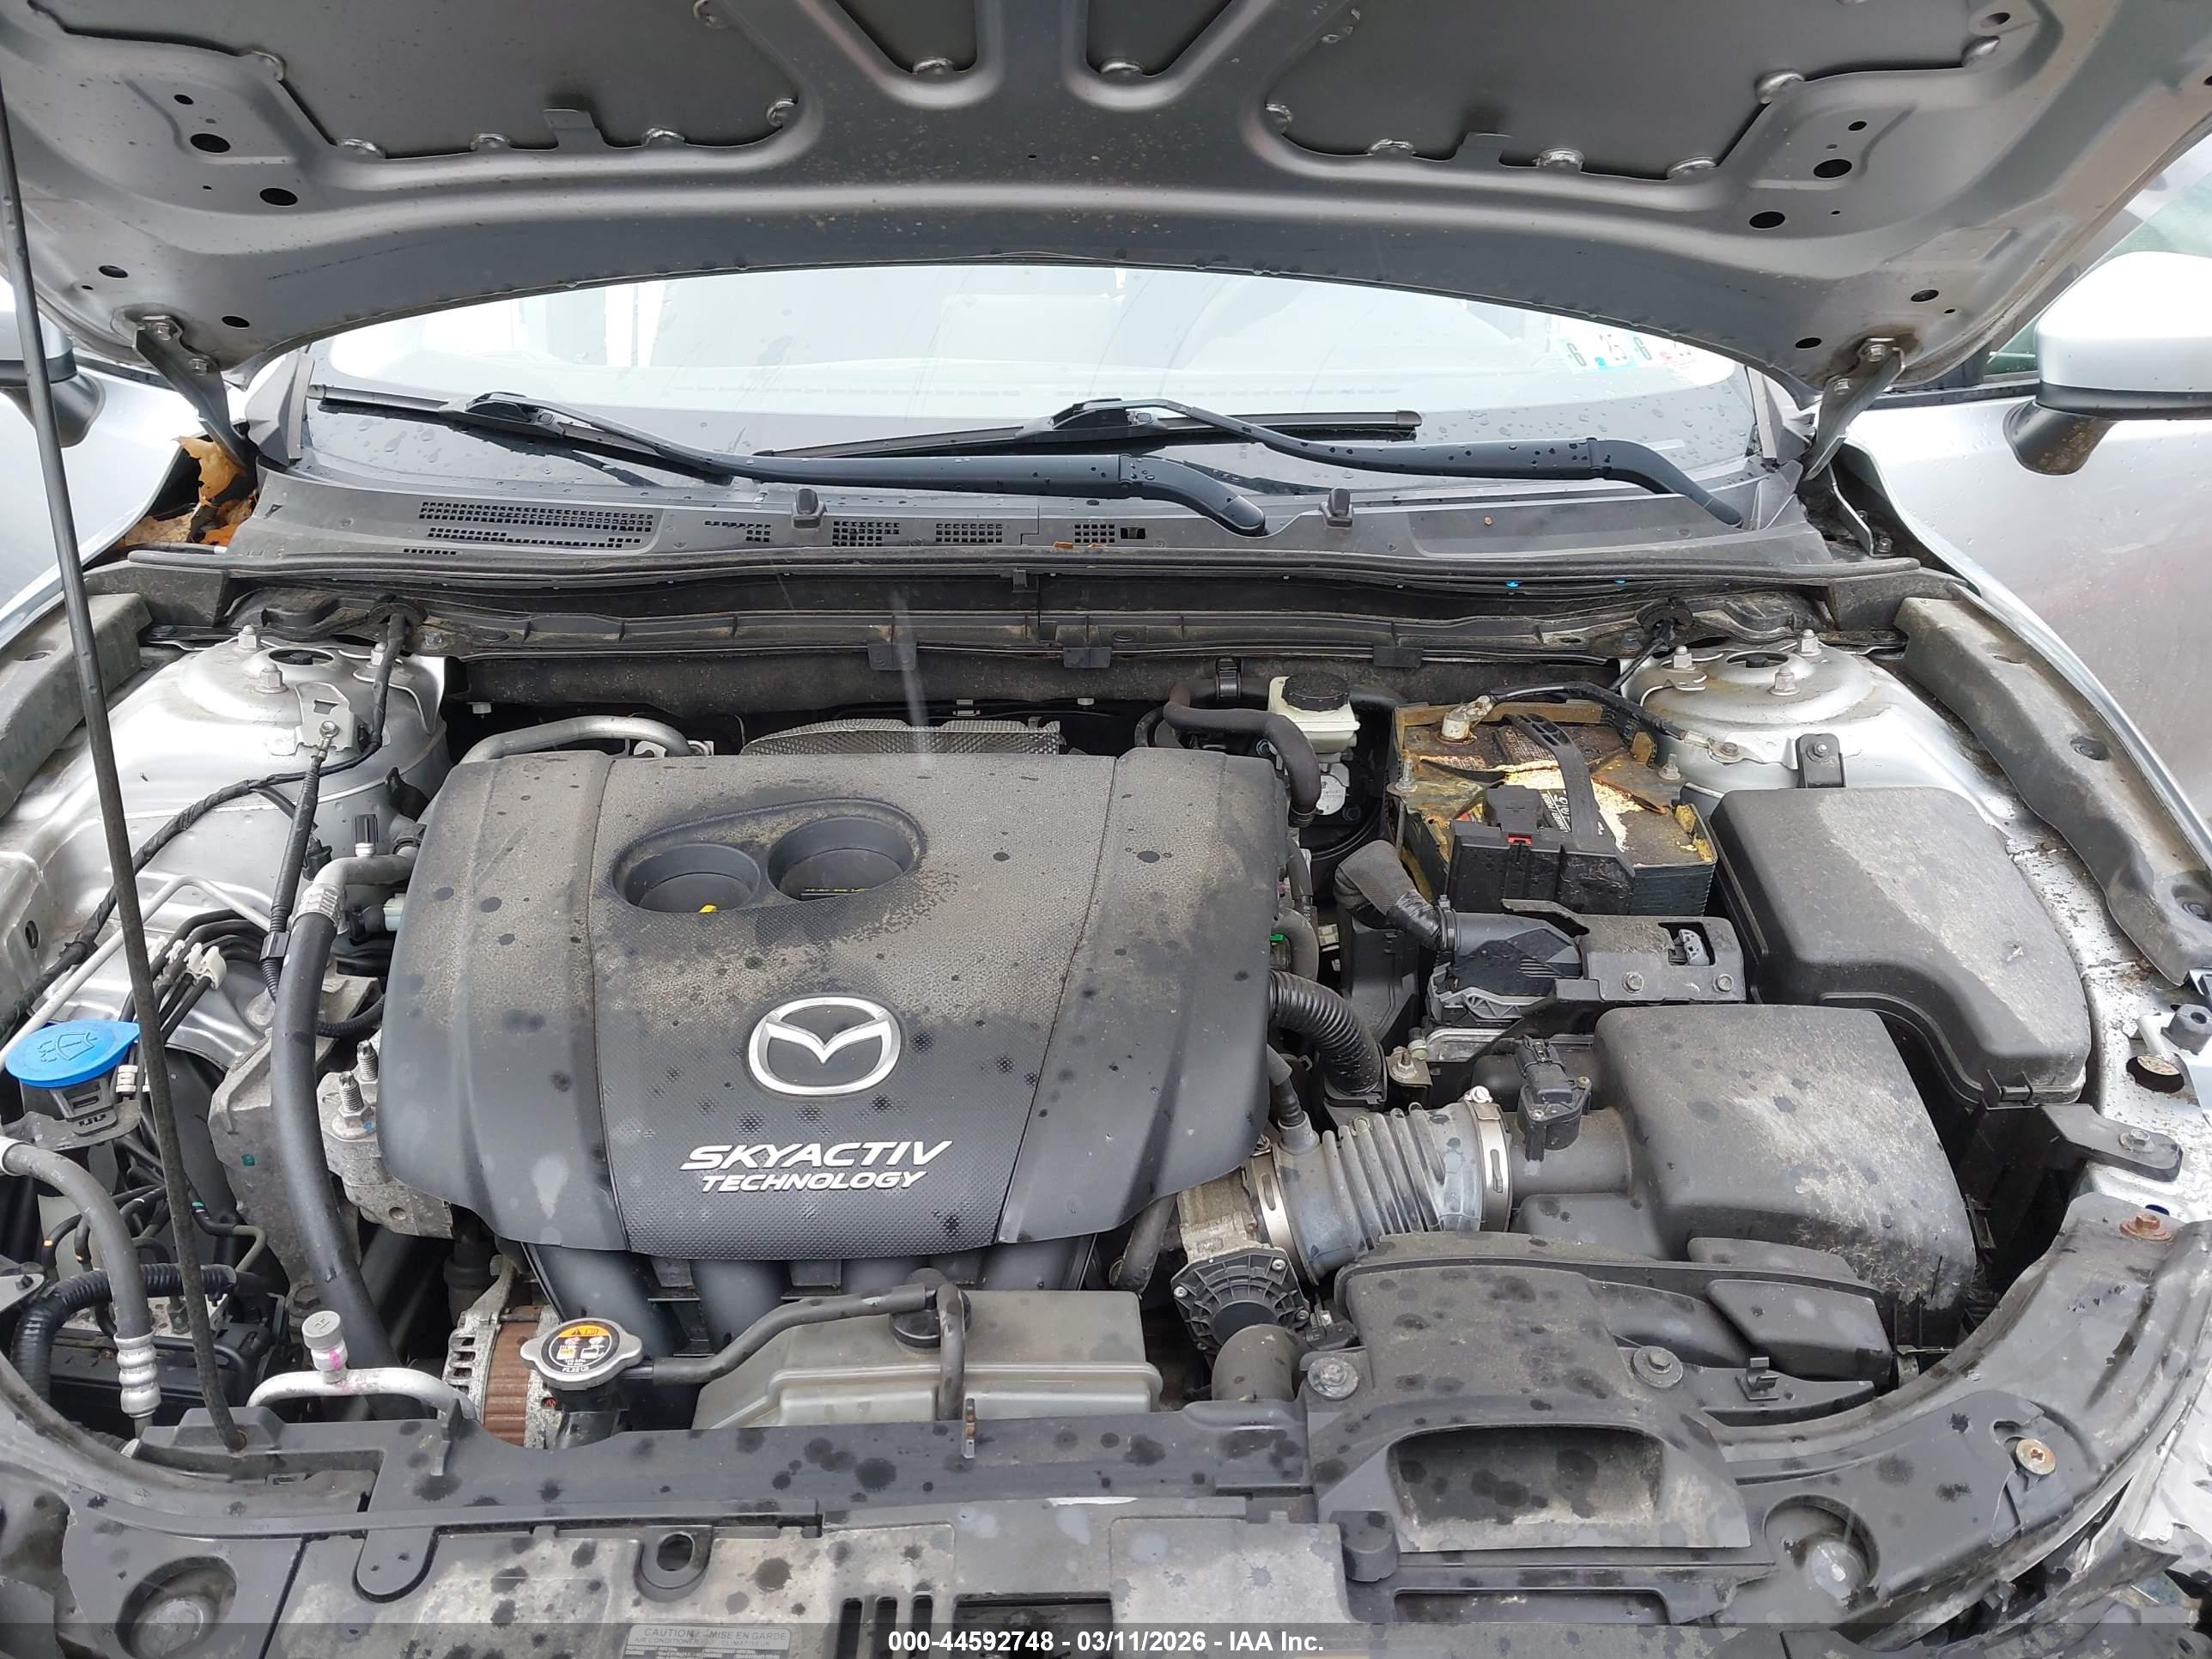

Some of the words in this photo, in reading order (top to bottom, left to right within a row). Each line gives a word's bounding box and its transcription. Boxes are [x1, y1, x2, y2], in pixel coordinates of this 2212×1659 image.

[679, 1139, 954, 1171] SKYACTIV
[701, 1170, 928, 1194] TECHNOLOGY
[644, 1627, 695, 1638] CAUTION
[751, 1632, 787, 1640] GARDE
[648, 1637, 700, 1645] CONDITIONER
